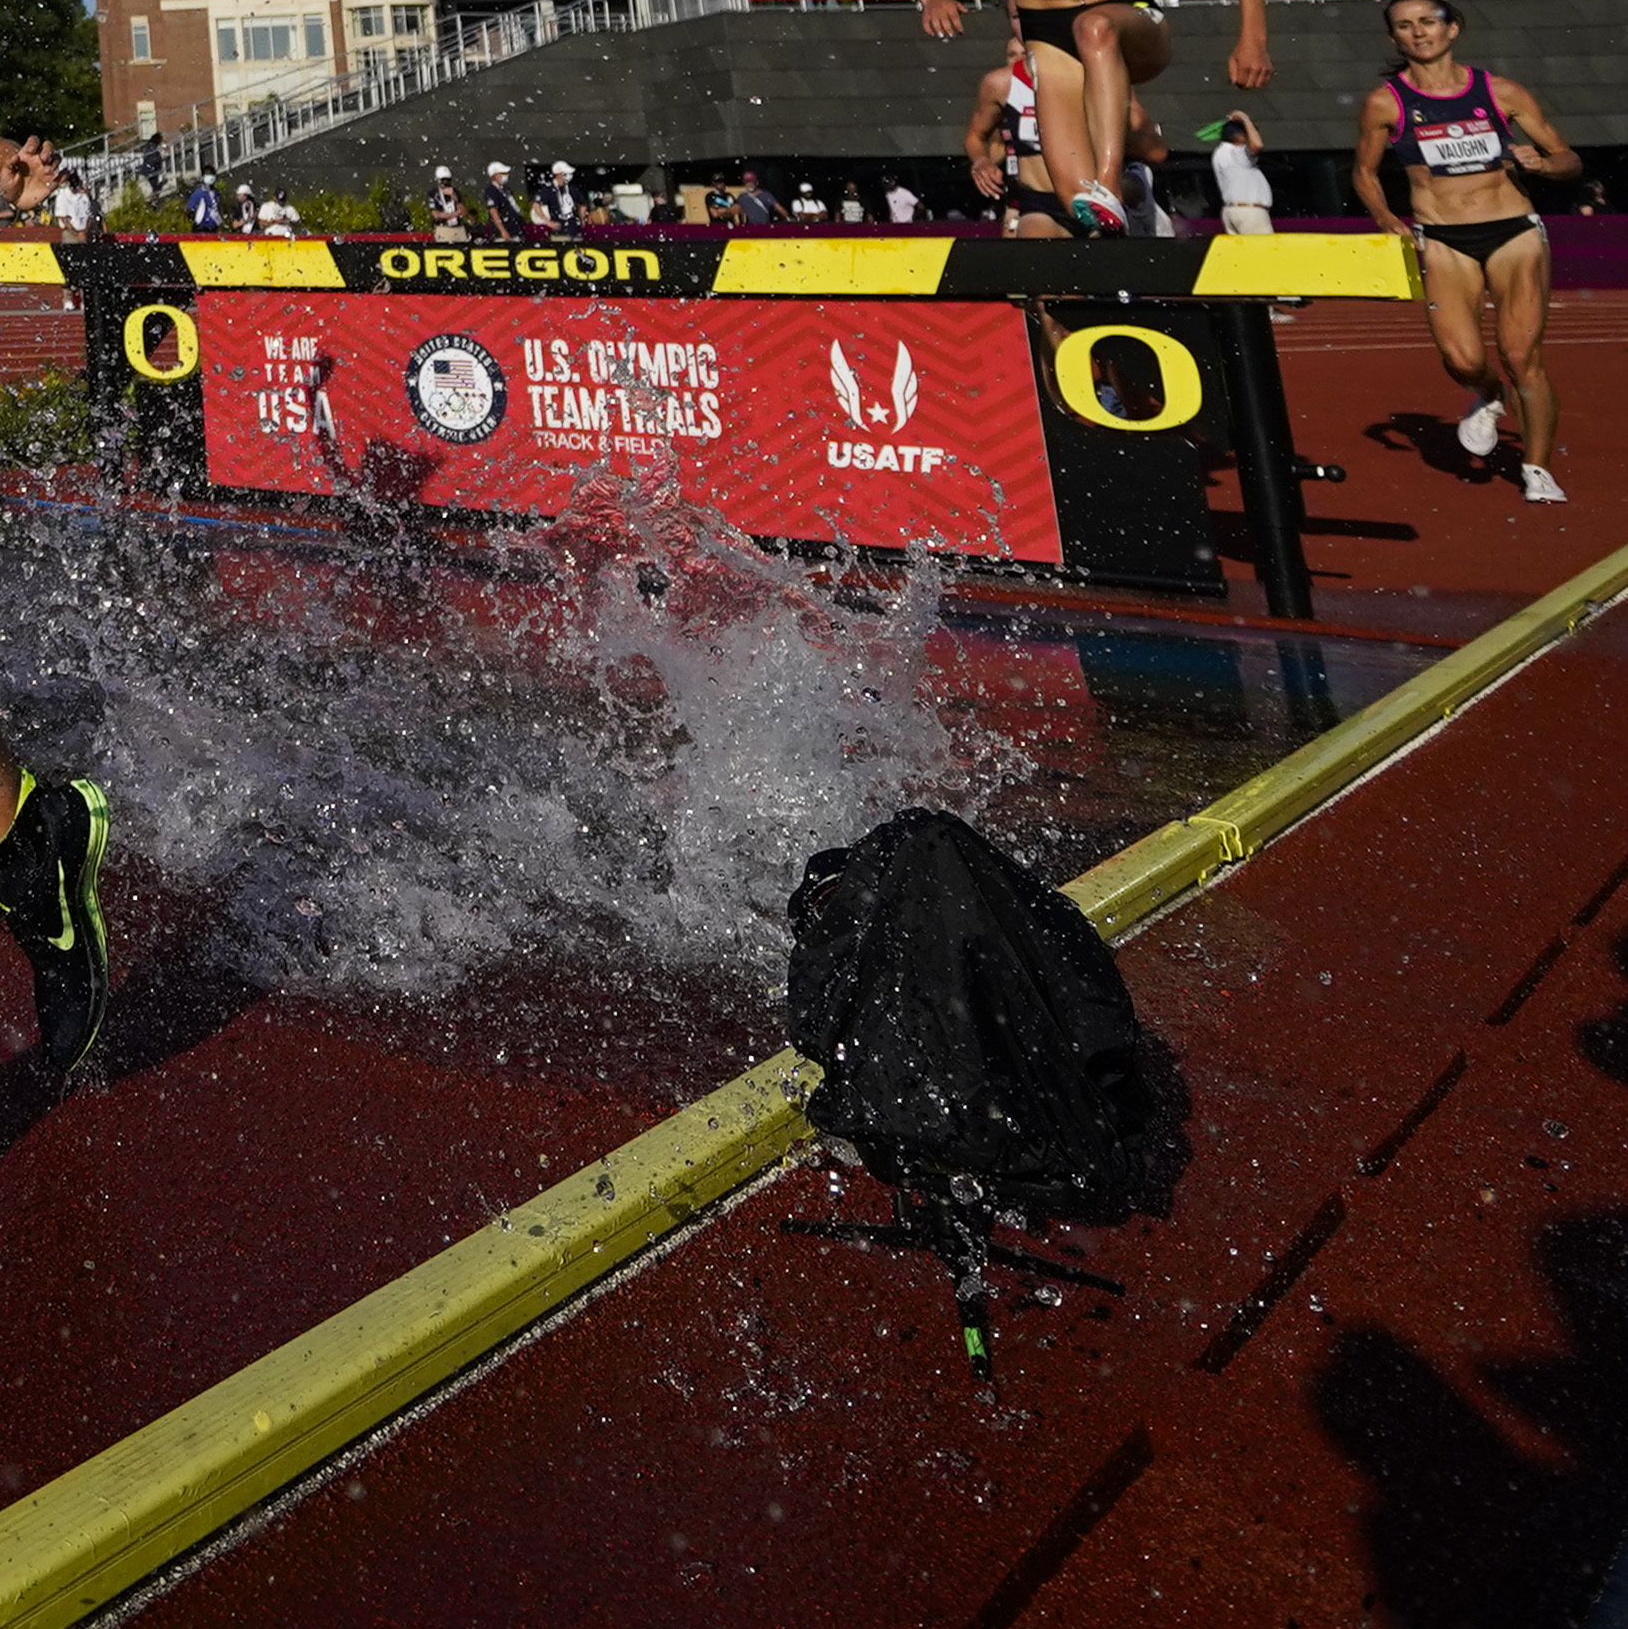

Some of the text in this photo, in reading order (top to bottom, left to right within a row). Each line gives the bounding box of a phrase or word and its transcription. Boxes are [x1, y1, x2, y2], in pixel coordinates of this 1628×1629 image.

[1436, 139, 1490, 160] VAUGHN
[379, 248, 660, 281] OREGON
[124, 304, 199, 380] O
[264, 336, 317, 361] WE ARE
[524, 339, 720, 390] U.S. OLYMPIC
[1055, 325, 1202, 431] O
[258, 387, 336, 440] USA
[527, 385, 610, 431] TEAM
[533, 431, 594, 451] TRACK
[615, 435, 664, 454] FIELD
[827, 440, 944, 474] USATF
